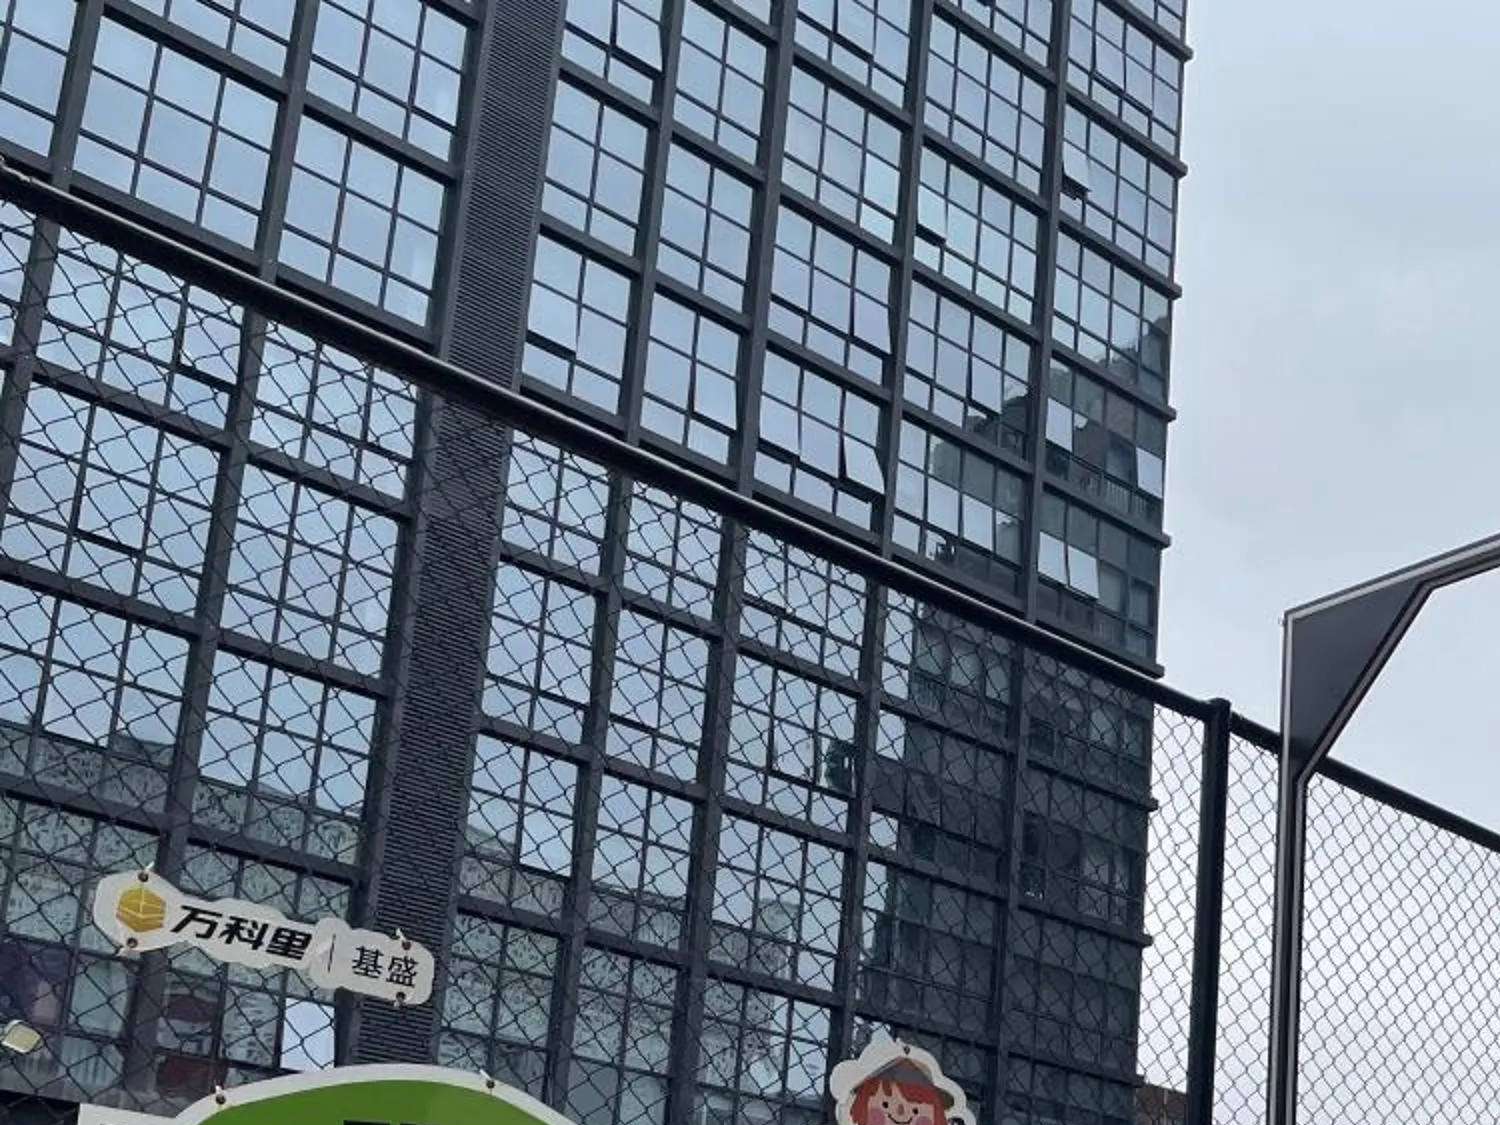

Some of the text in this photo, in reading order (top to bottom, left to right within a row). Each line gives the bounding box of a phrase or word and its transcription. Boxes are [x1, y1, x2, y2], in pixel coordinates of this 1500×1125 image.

[170, 904, 420, 988] 万科里 基盛
